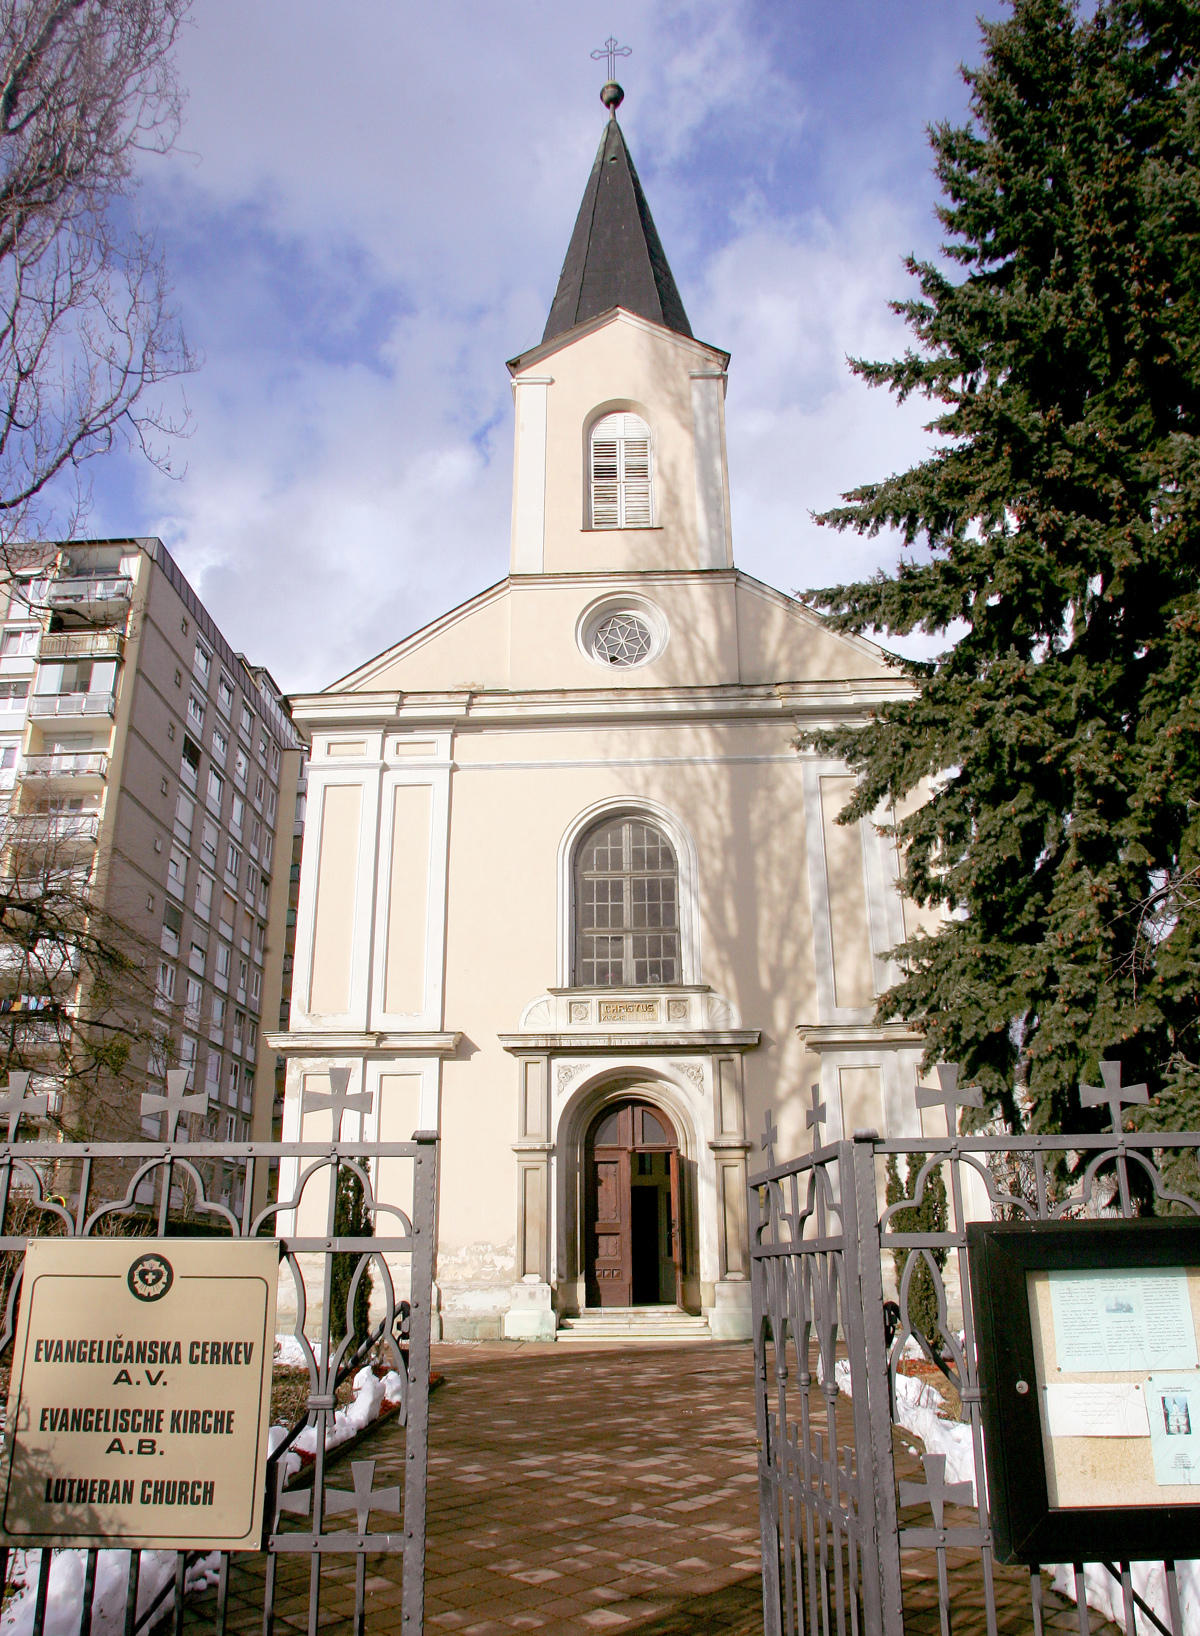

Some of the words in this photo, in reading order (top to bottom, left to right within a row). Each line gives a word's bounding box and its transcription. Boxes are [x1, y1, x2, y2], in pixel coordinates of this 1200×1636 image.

[605, 1003, 655, 1013] CHRISTUS
[34, 1333, 182, 1364] EVANGELIČANSKA
[188, 1340, 254, 1365] CERKEV
[112, 1369, 168, 1386] A.V.
[39, 1407, 165, 1433] EVANGELISCHE
[169, 1409, 235, 1434] KIRCHE
[105, 1437, 165, 1456] A.B.
[44, 1478, 135, 1504] LUTHERAN
[140, 1479, 215, 1505] CHURCH
